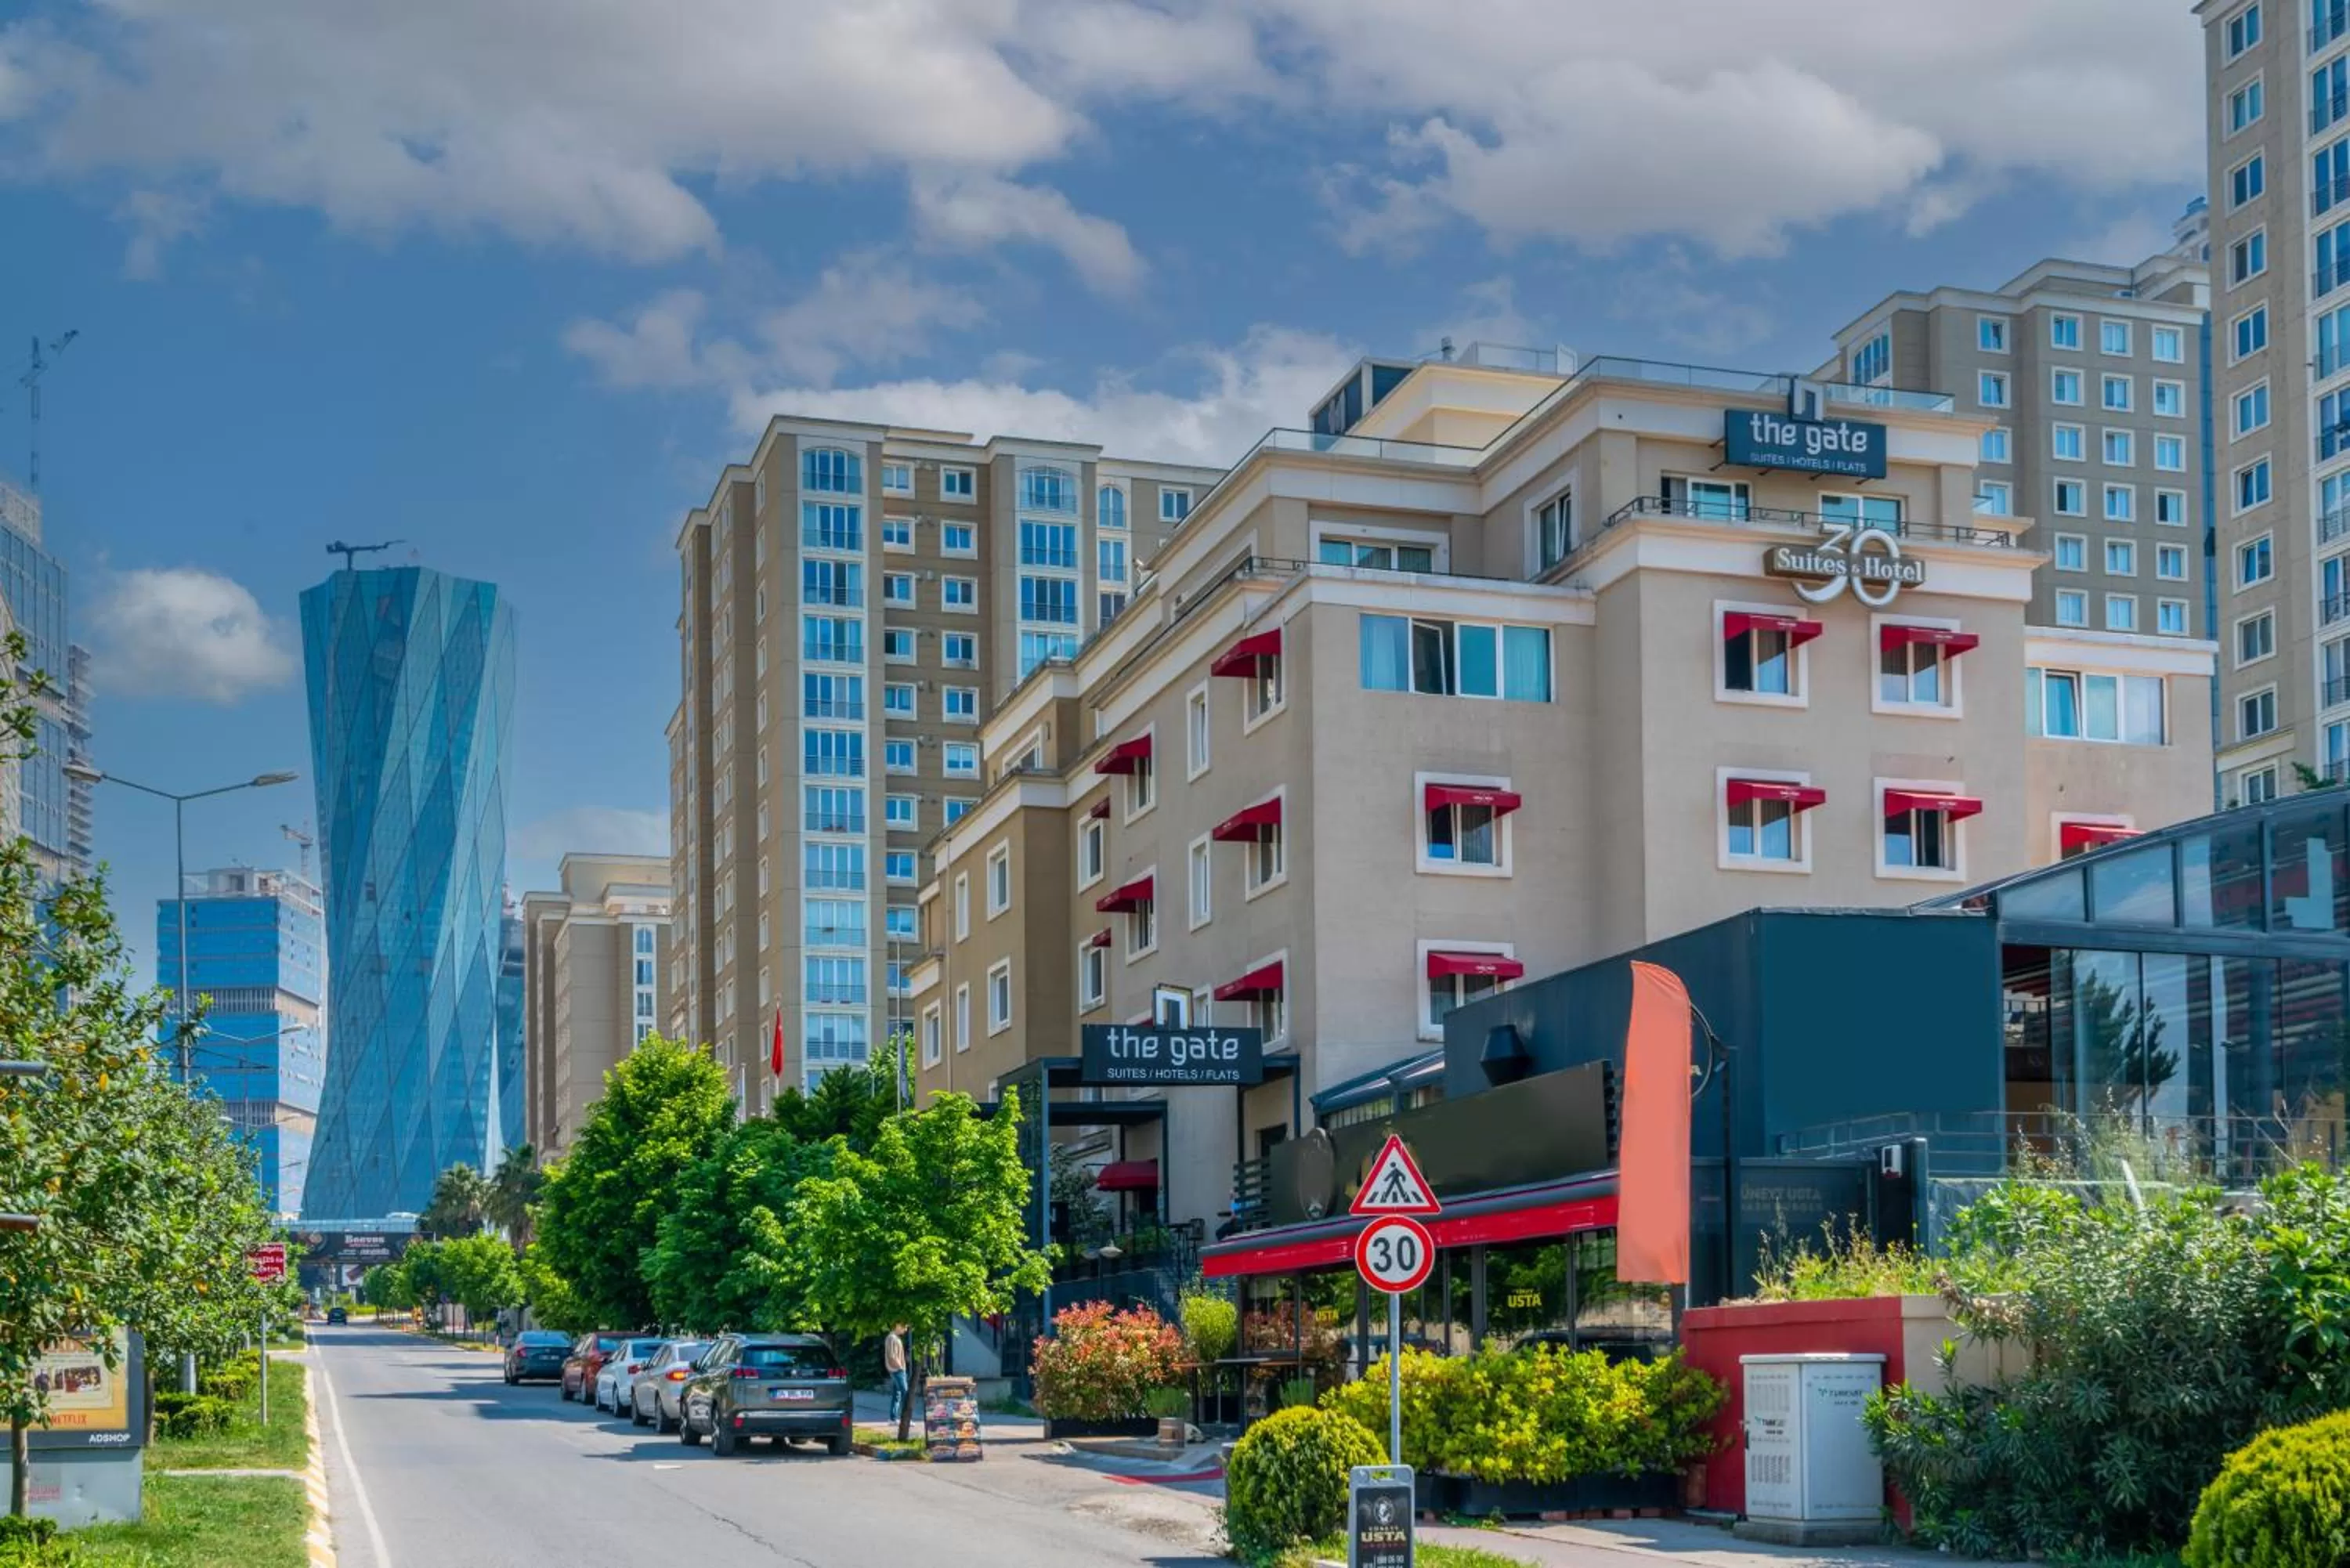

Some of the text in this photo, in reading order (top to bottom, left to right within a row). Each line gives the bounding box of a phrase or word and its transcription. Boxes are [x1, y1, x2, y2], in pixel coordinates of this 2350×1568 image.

[1750, 413, 1867, 455] the gate
[1750, 452, 1785, 465] SUITES
[1791, 456, 1829, 469] HOTELS
[1837, 461, 1867, 473] FLATS
[1777, 547, 1847, 575] Suites
[1864, 557, 1924, 582] Hotel
[1792, 522, 1900, 606] 30
[1107, 1028, 1238, 1066] the gate
[1107, 1068, 1147, 1078] SUITES
[1155, 1069, 1198, 1080] HOTELS
[1206, 1070, 1240, 1080] FLATS
[1372, 1235, 1415, 1272] 30
[1507, 1294, 1542, 1308] USTA
[50, 1414, 88, 1425] NETFLIX
[89, 1433, 132, 1443] ADSHOP
[1361, 1531, 1407, 1542] USTA
